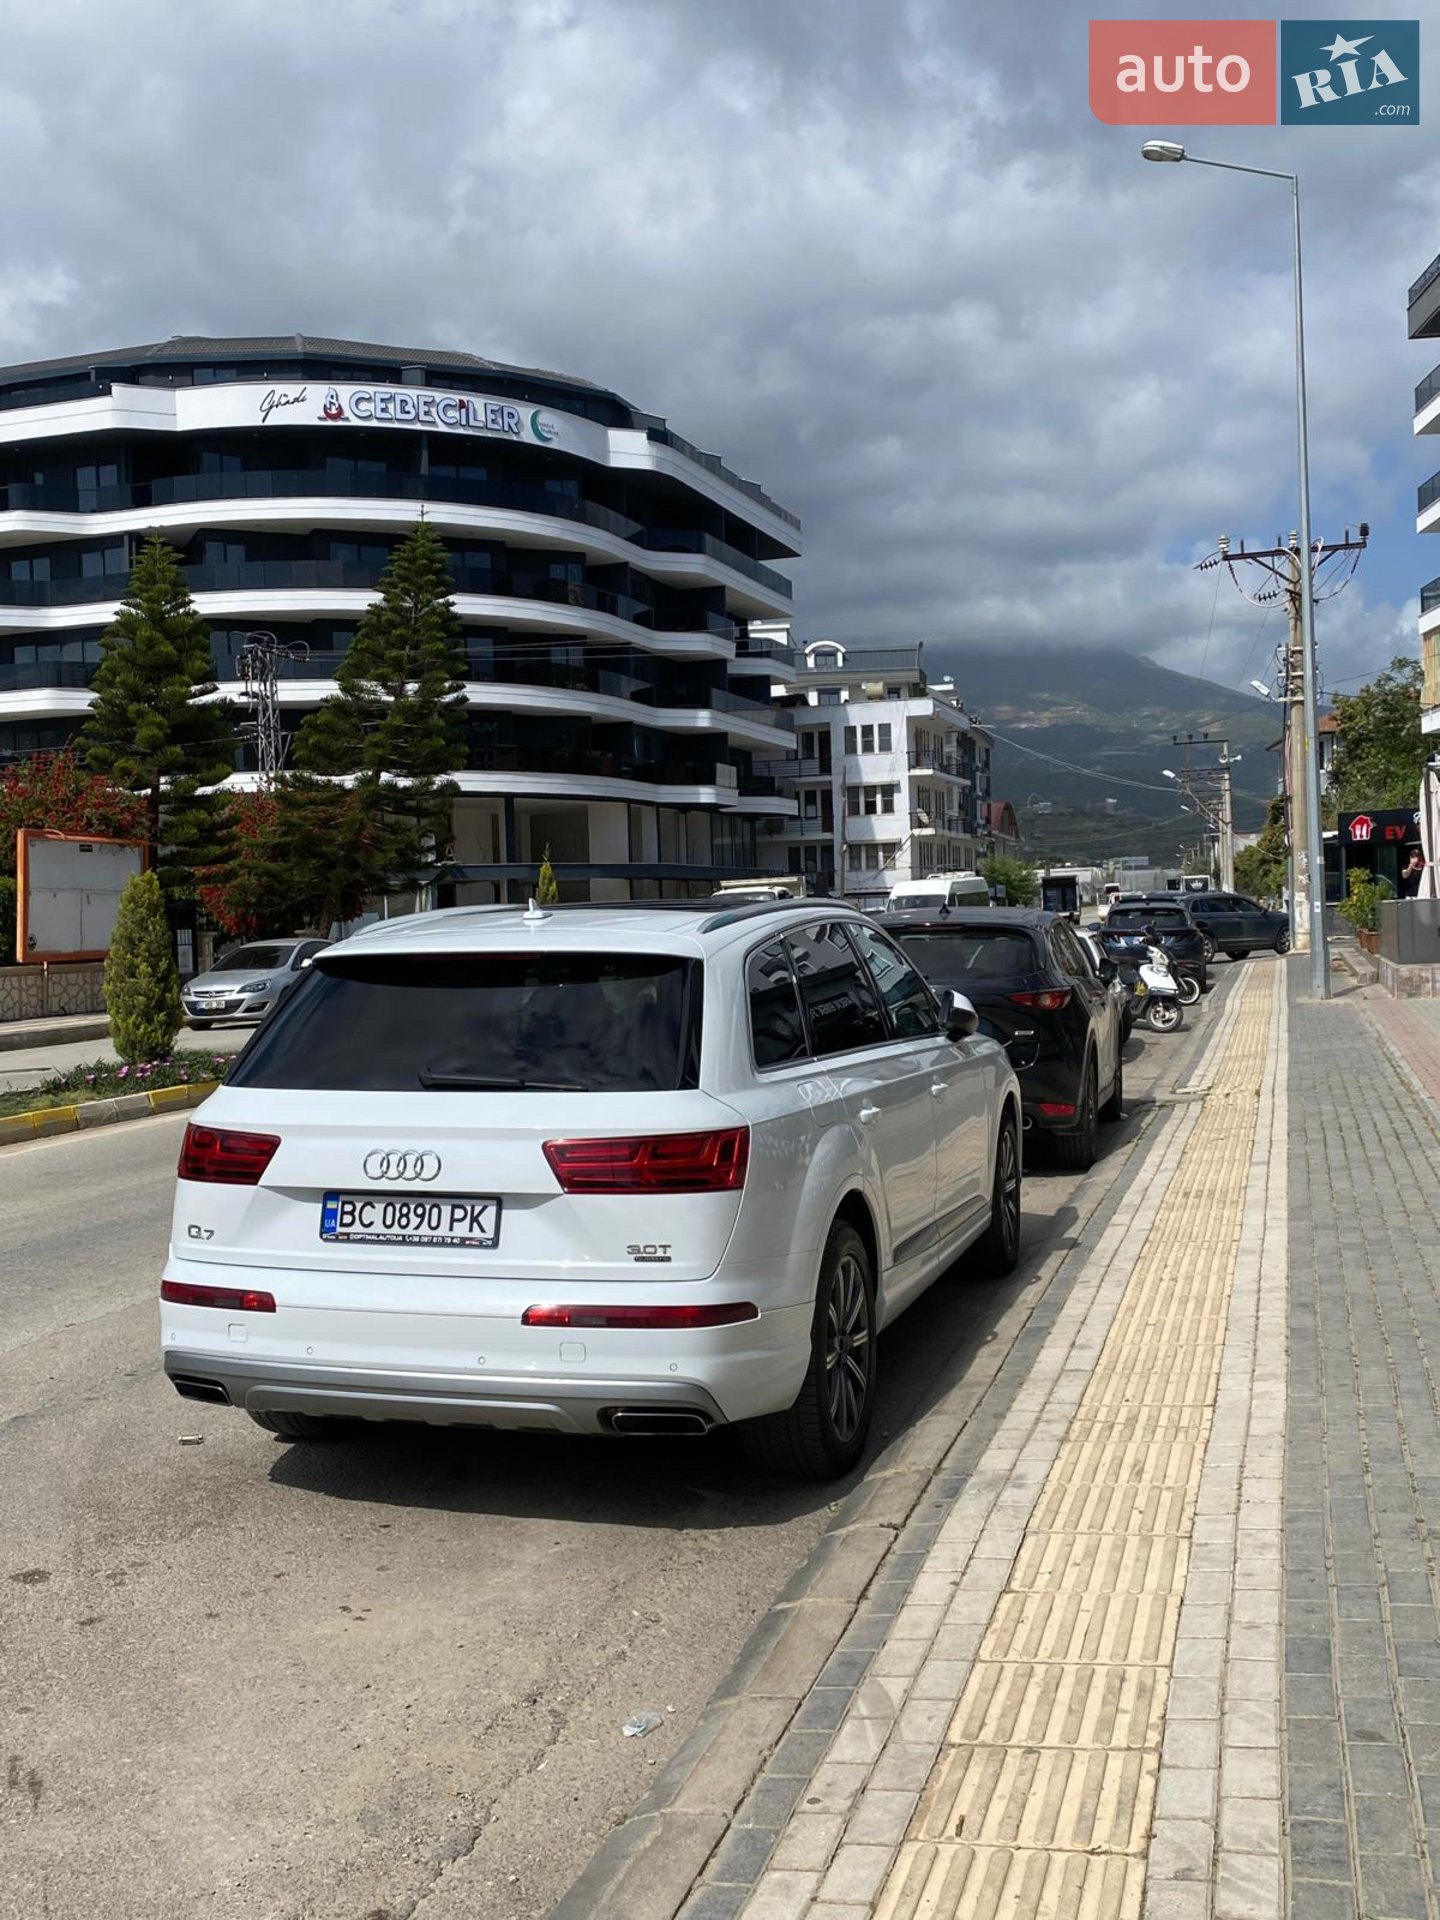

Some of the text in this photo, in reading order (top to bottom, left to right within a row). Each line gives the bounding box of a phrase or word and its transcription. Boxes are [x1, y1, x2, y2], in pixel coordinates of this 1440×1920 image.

[1384, 825, 1406, 840] EV
[325, 1219, 336, 1228] UA
[340, 1200, 489, 1234] BC 0890 PK
[188, 1224, 215, 1240] Q7
